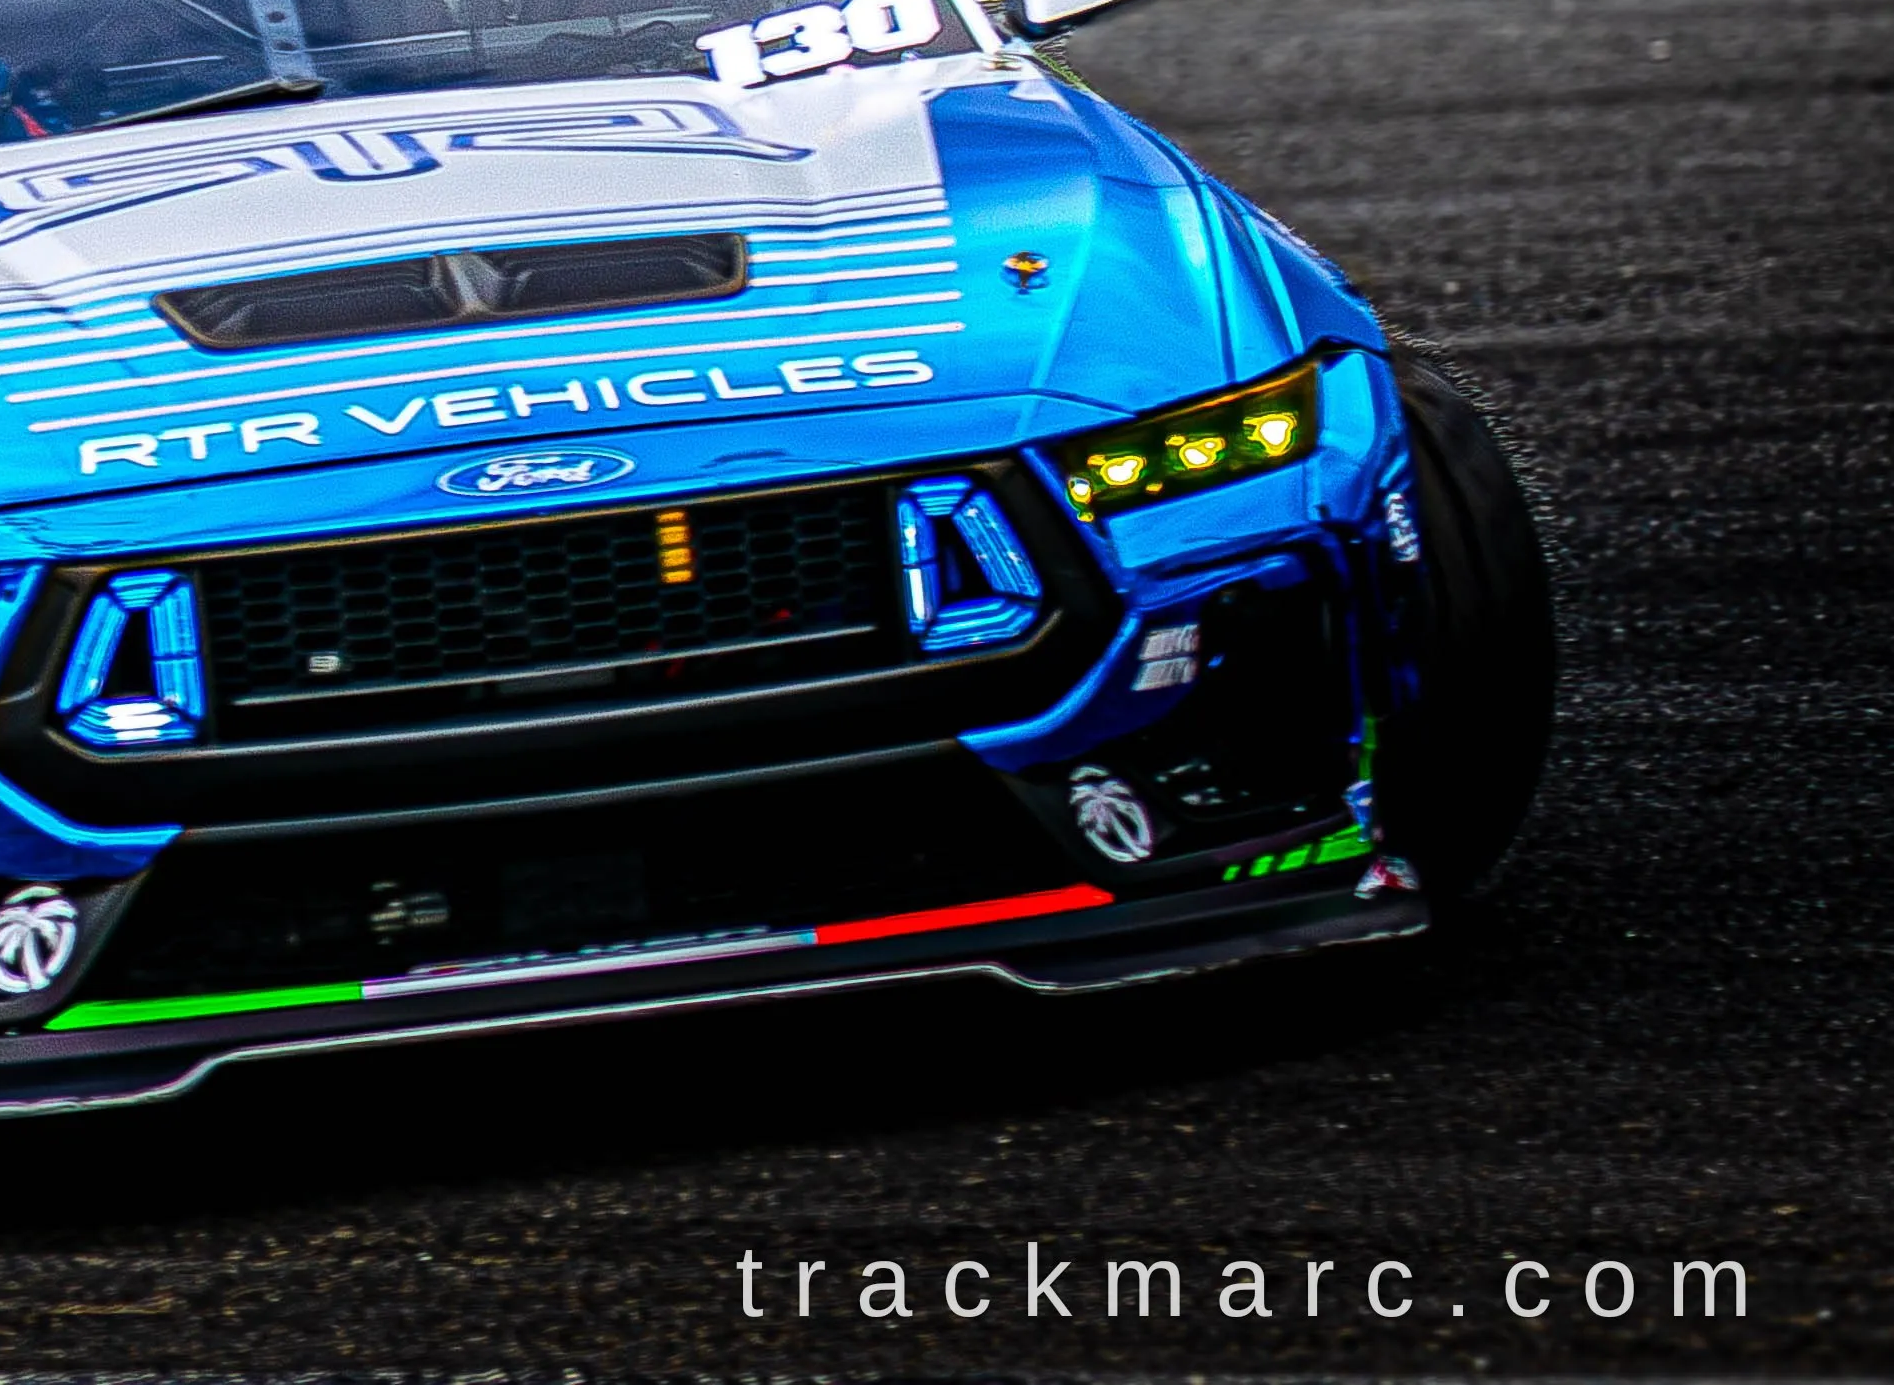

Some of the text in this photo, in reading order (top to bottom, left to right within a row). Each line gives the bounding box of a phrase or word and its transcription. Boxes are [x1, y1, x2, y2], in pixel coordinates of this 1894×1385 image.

[77, 348, 935, 476] RTR VEHICLES
[476, 455, 597, 493] Ford
